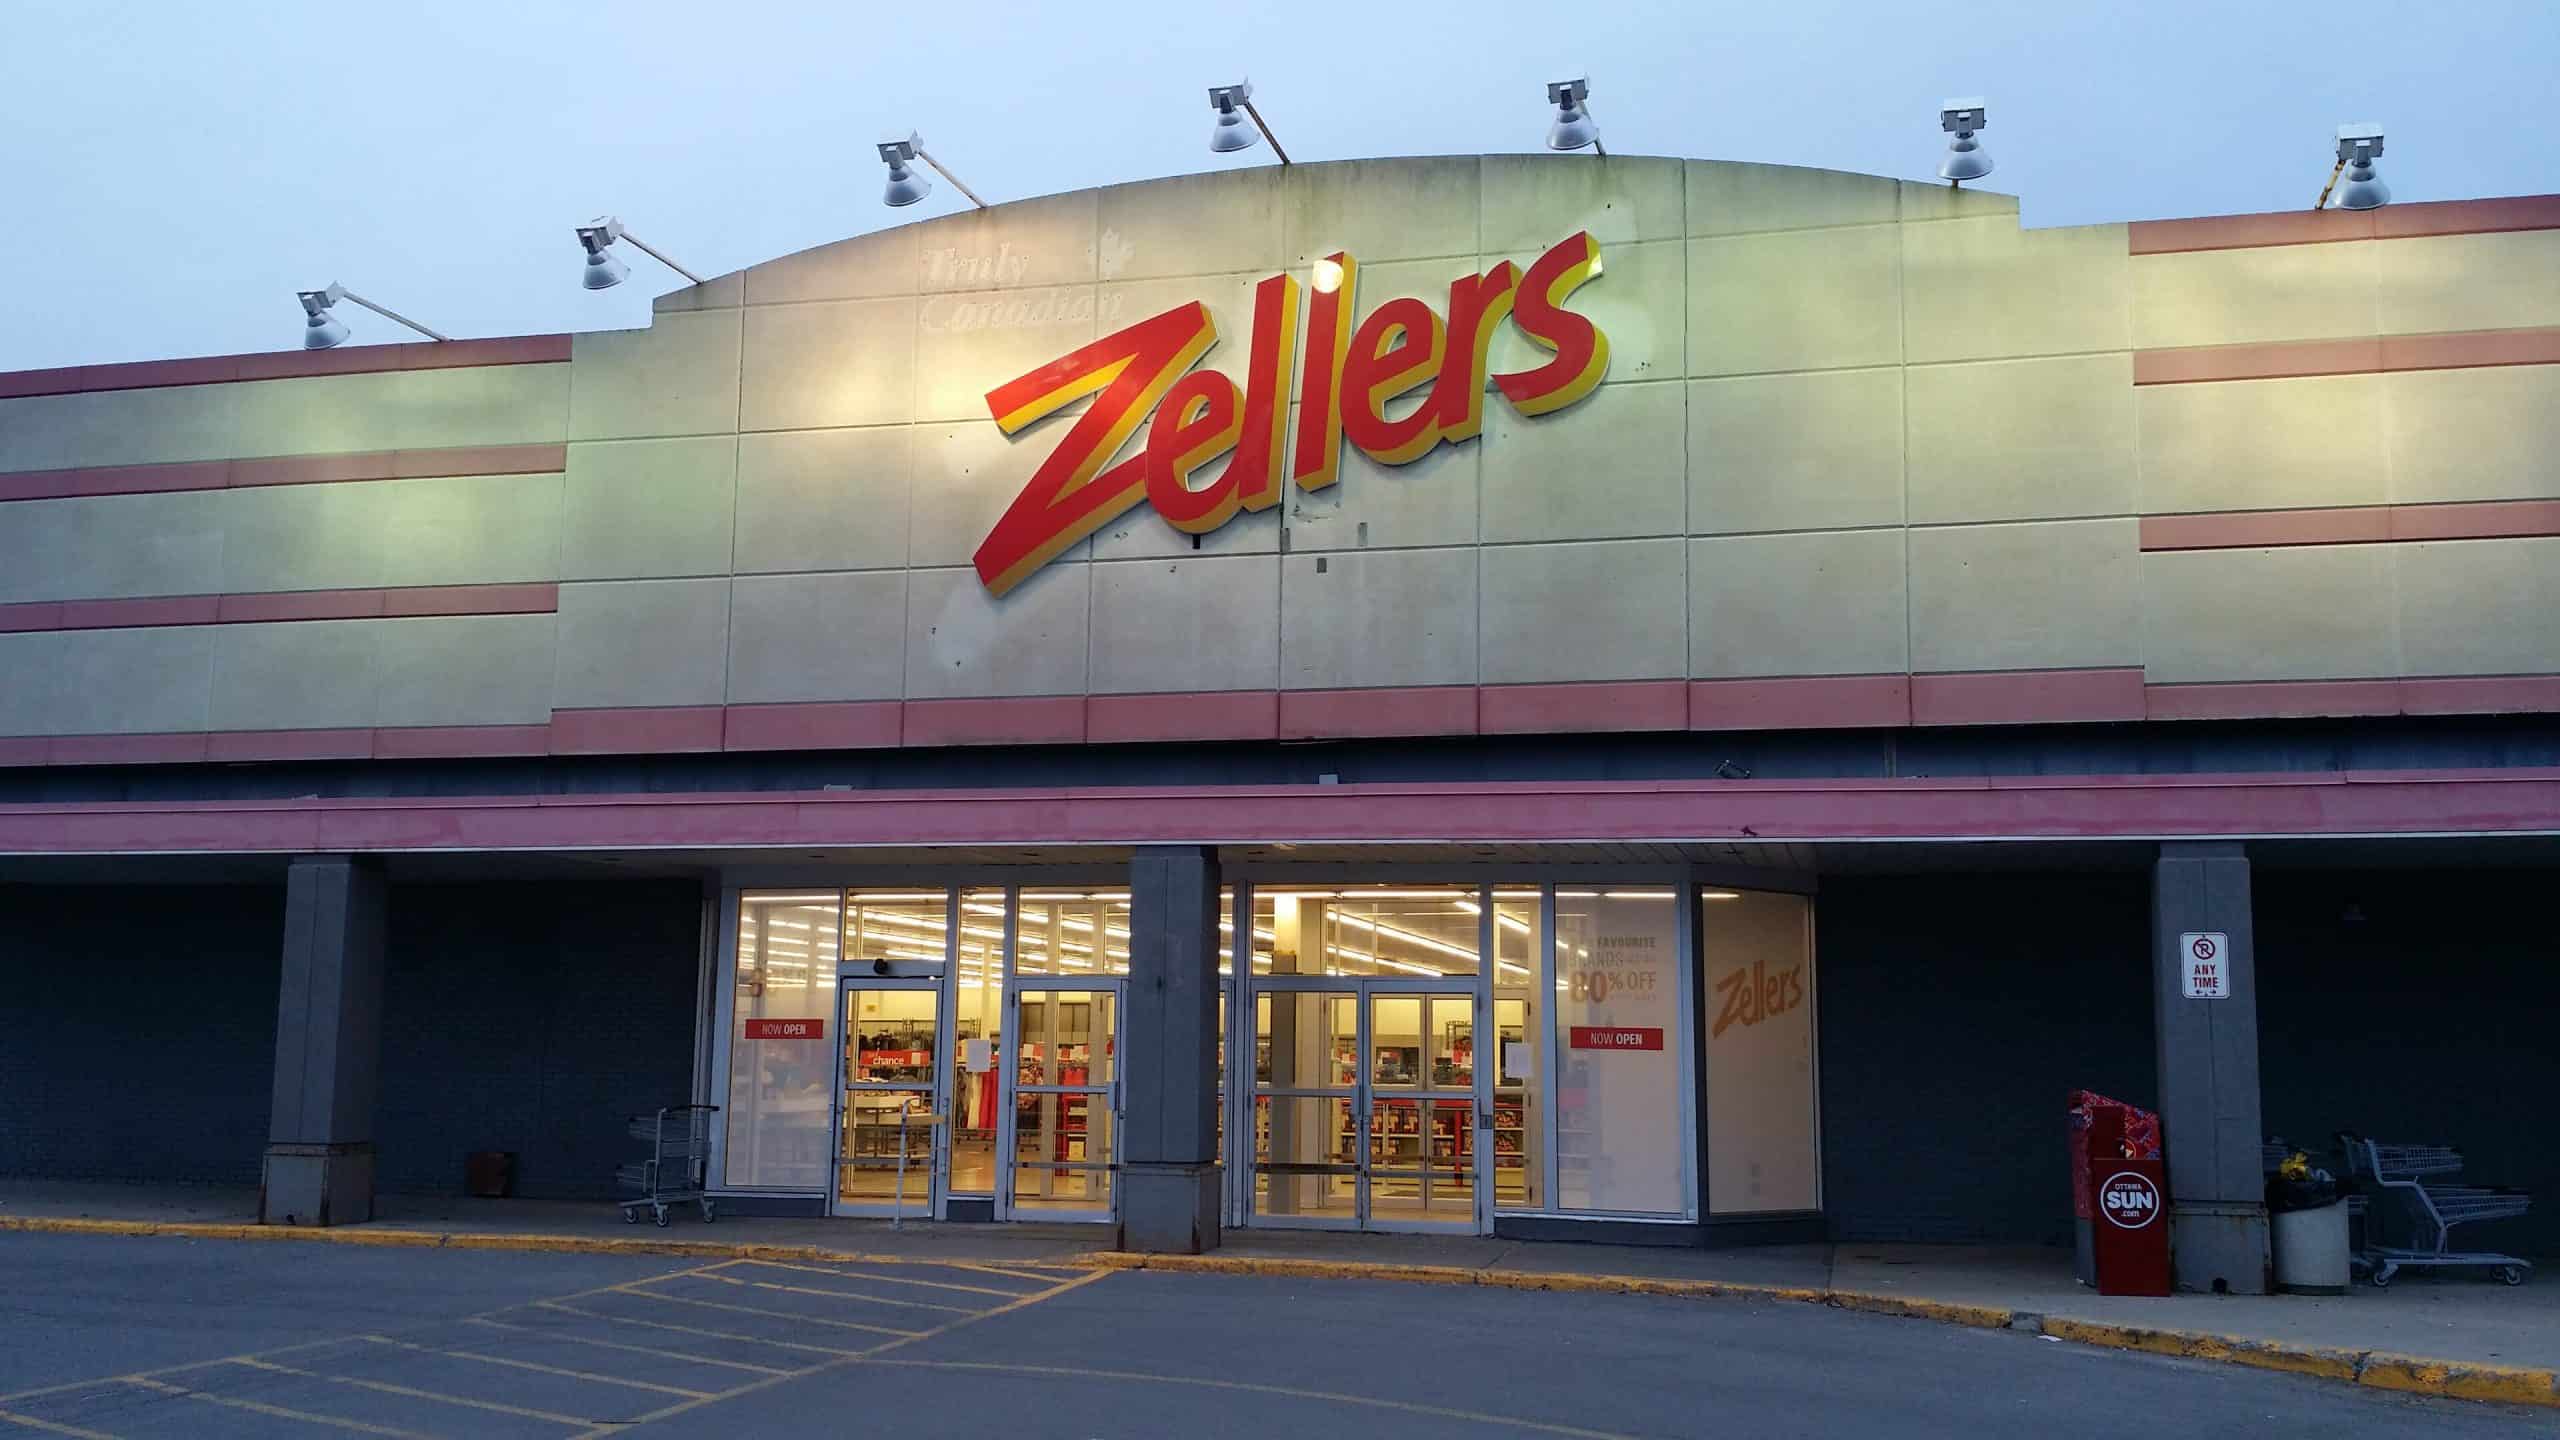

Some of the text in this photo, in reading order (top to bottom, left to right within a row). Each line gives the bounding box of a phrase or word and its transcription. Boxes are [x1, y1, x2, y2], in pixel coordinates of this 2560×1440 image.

[973, 231, 1609, 598] Zellers
[1598, 936, 1656, 948] FAVOURITE
[2194, 964, 2216, 975] ANY
[1627, 971, 1657, 990] OFF
[2192, 977, 2219, 988] TIME
[1711, 960, 1802, 1039] Zellers
[762, 1024, 807, 1035] NOW OPEN
[1591, 1032, 1643, 1045] NOW OPEN
[873, 1055, 905, 1065] chance
[2114, 1183, 2142, 1191] OTTAWA
[2107, 1191, 2153, 1209] SUN
